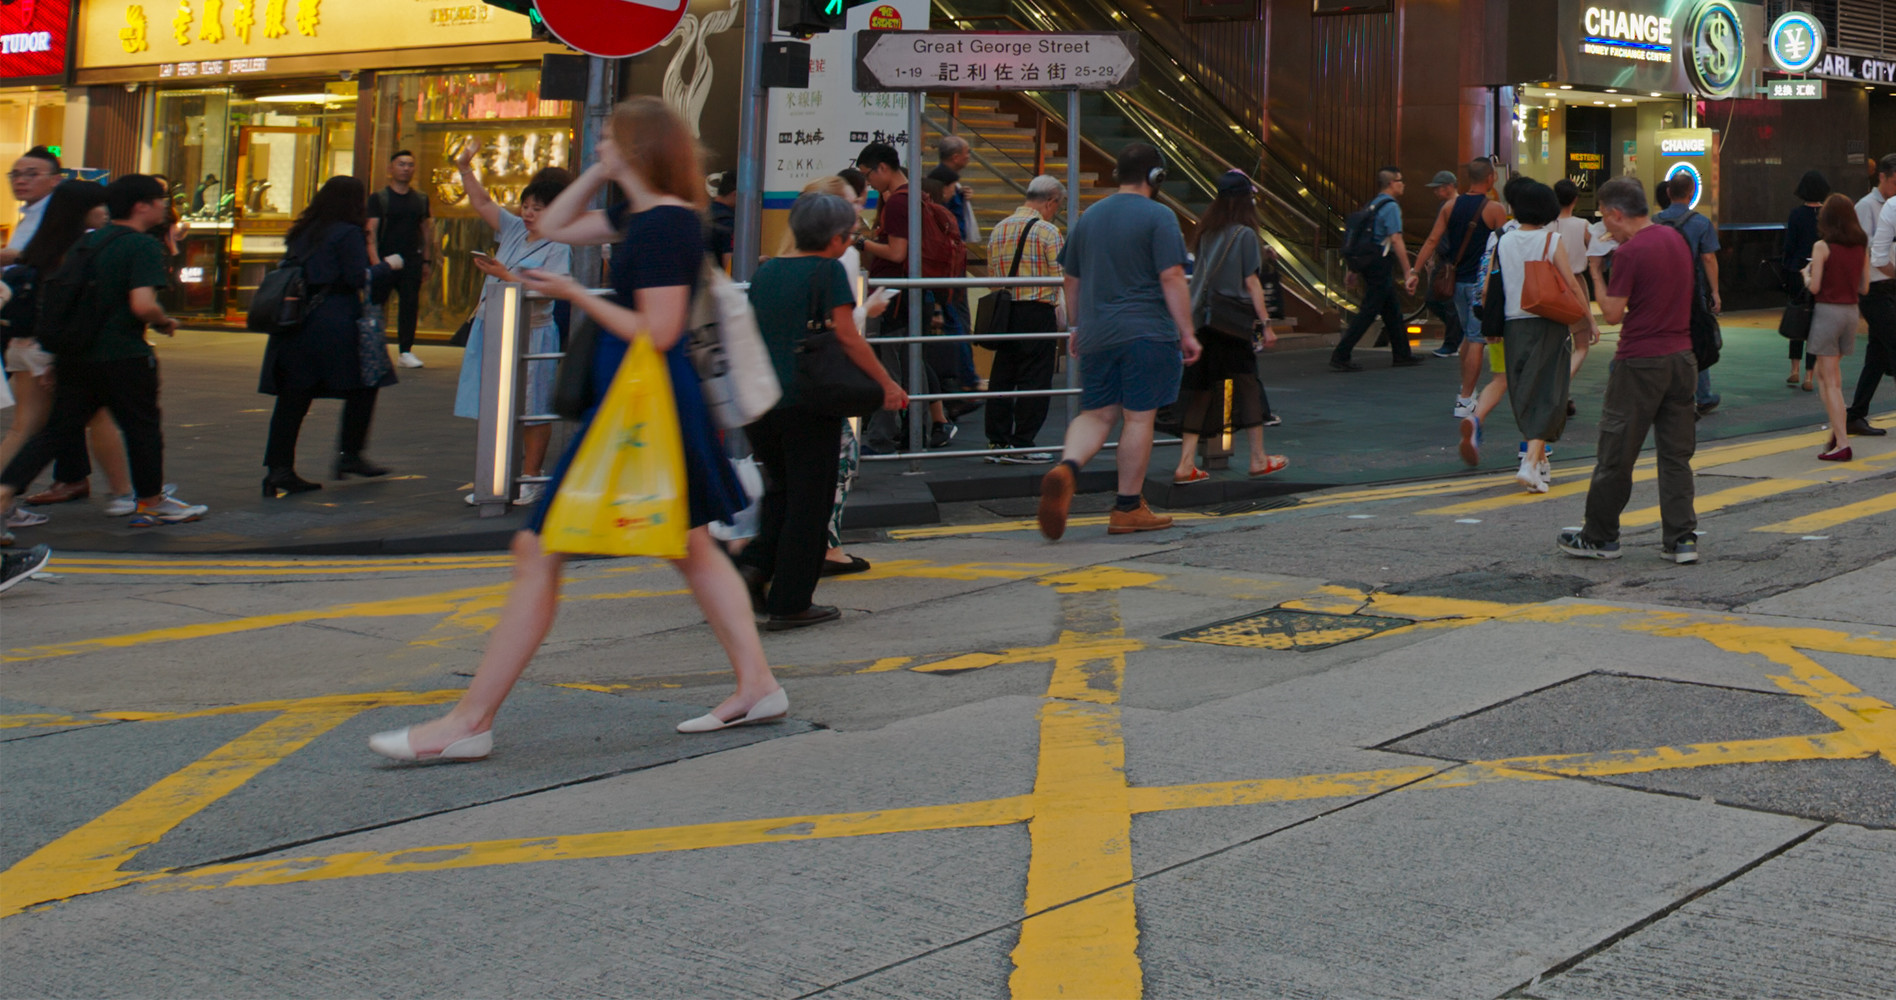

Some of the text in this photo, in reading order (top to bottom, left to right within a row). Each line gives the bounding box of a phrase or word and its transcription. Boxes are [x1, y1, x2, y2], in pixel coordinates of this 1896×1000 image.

[1585, 6, 1673, 45] CHANGE
[0, 31, 51, 54] TUDOR
[913, 39, 1090, 56] Great George Street
[1585, 44, 1672, 63] MONEY EXCHANGE CENTRE
[895, 62, 1114, 81] 1-19 記利佐治街 25-29
[1812, 54, 1854, 78] EARL
[1861, 59, 1896, 81] CITY
[1661, 138, 1705, 152] CHANGE
[1570, 152, 1602, 162] WESTERN
[1579, 162, 1602, 170] UNION
